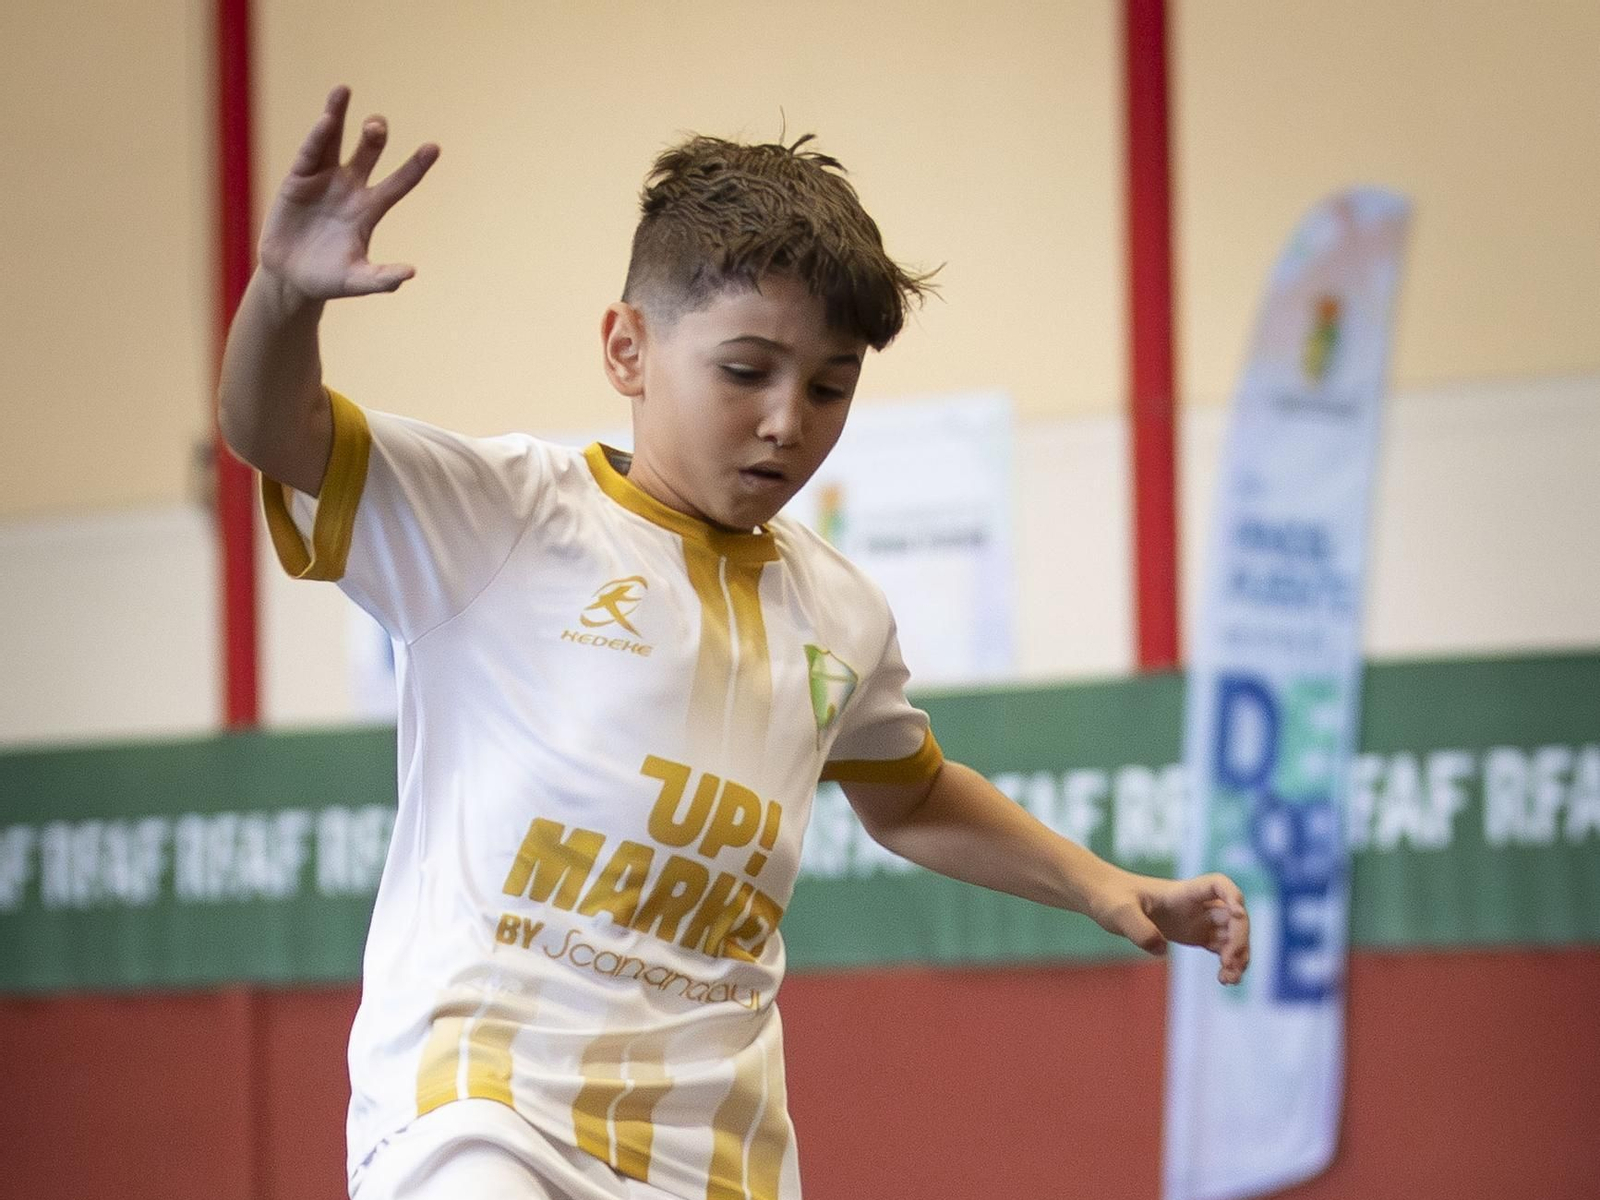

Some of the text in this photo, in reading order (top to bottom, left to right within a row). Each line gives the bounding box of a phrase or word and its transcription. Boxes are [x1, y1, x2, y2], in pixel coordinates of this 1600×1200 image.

[640, 754, 782, 878] UP!
[1347, 749, 1474, 852] FAF
[1484, 743, 1600, 848] RFA
[495, 913, 544, 949] BY
